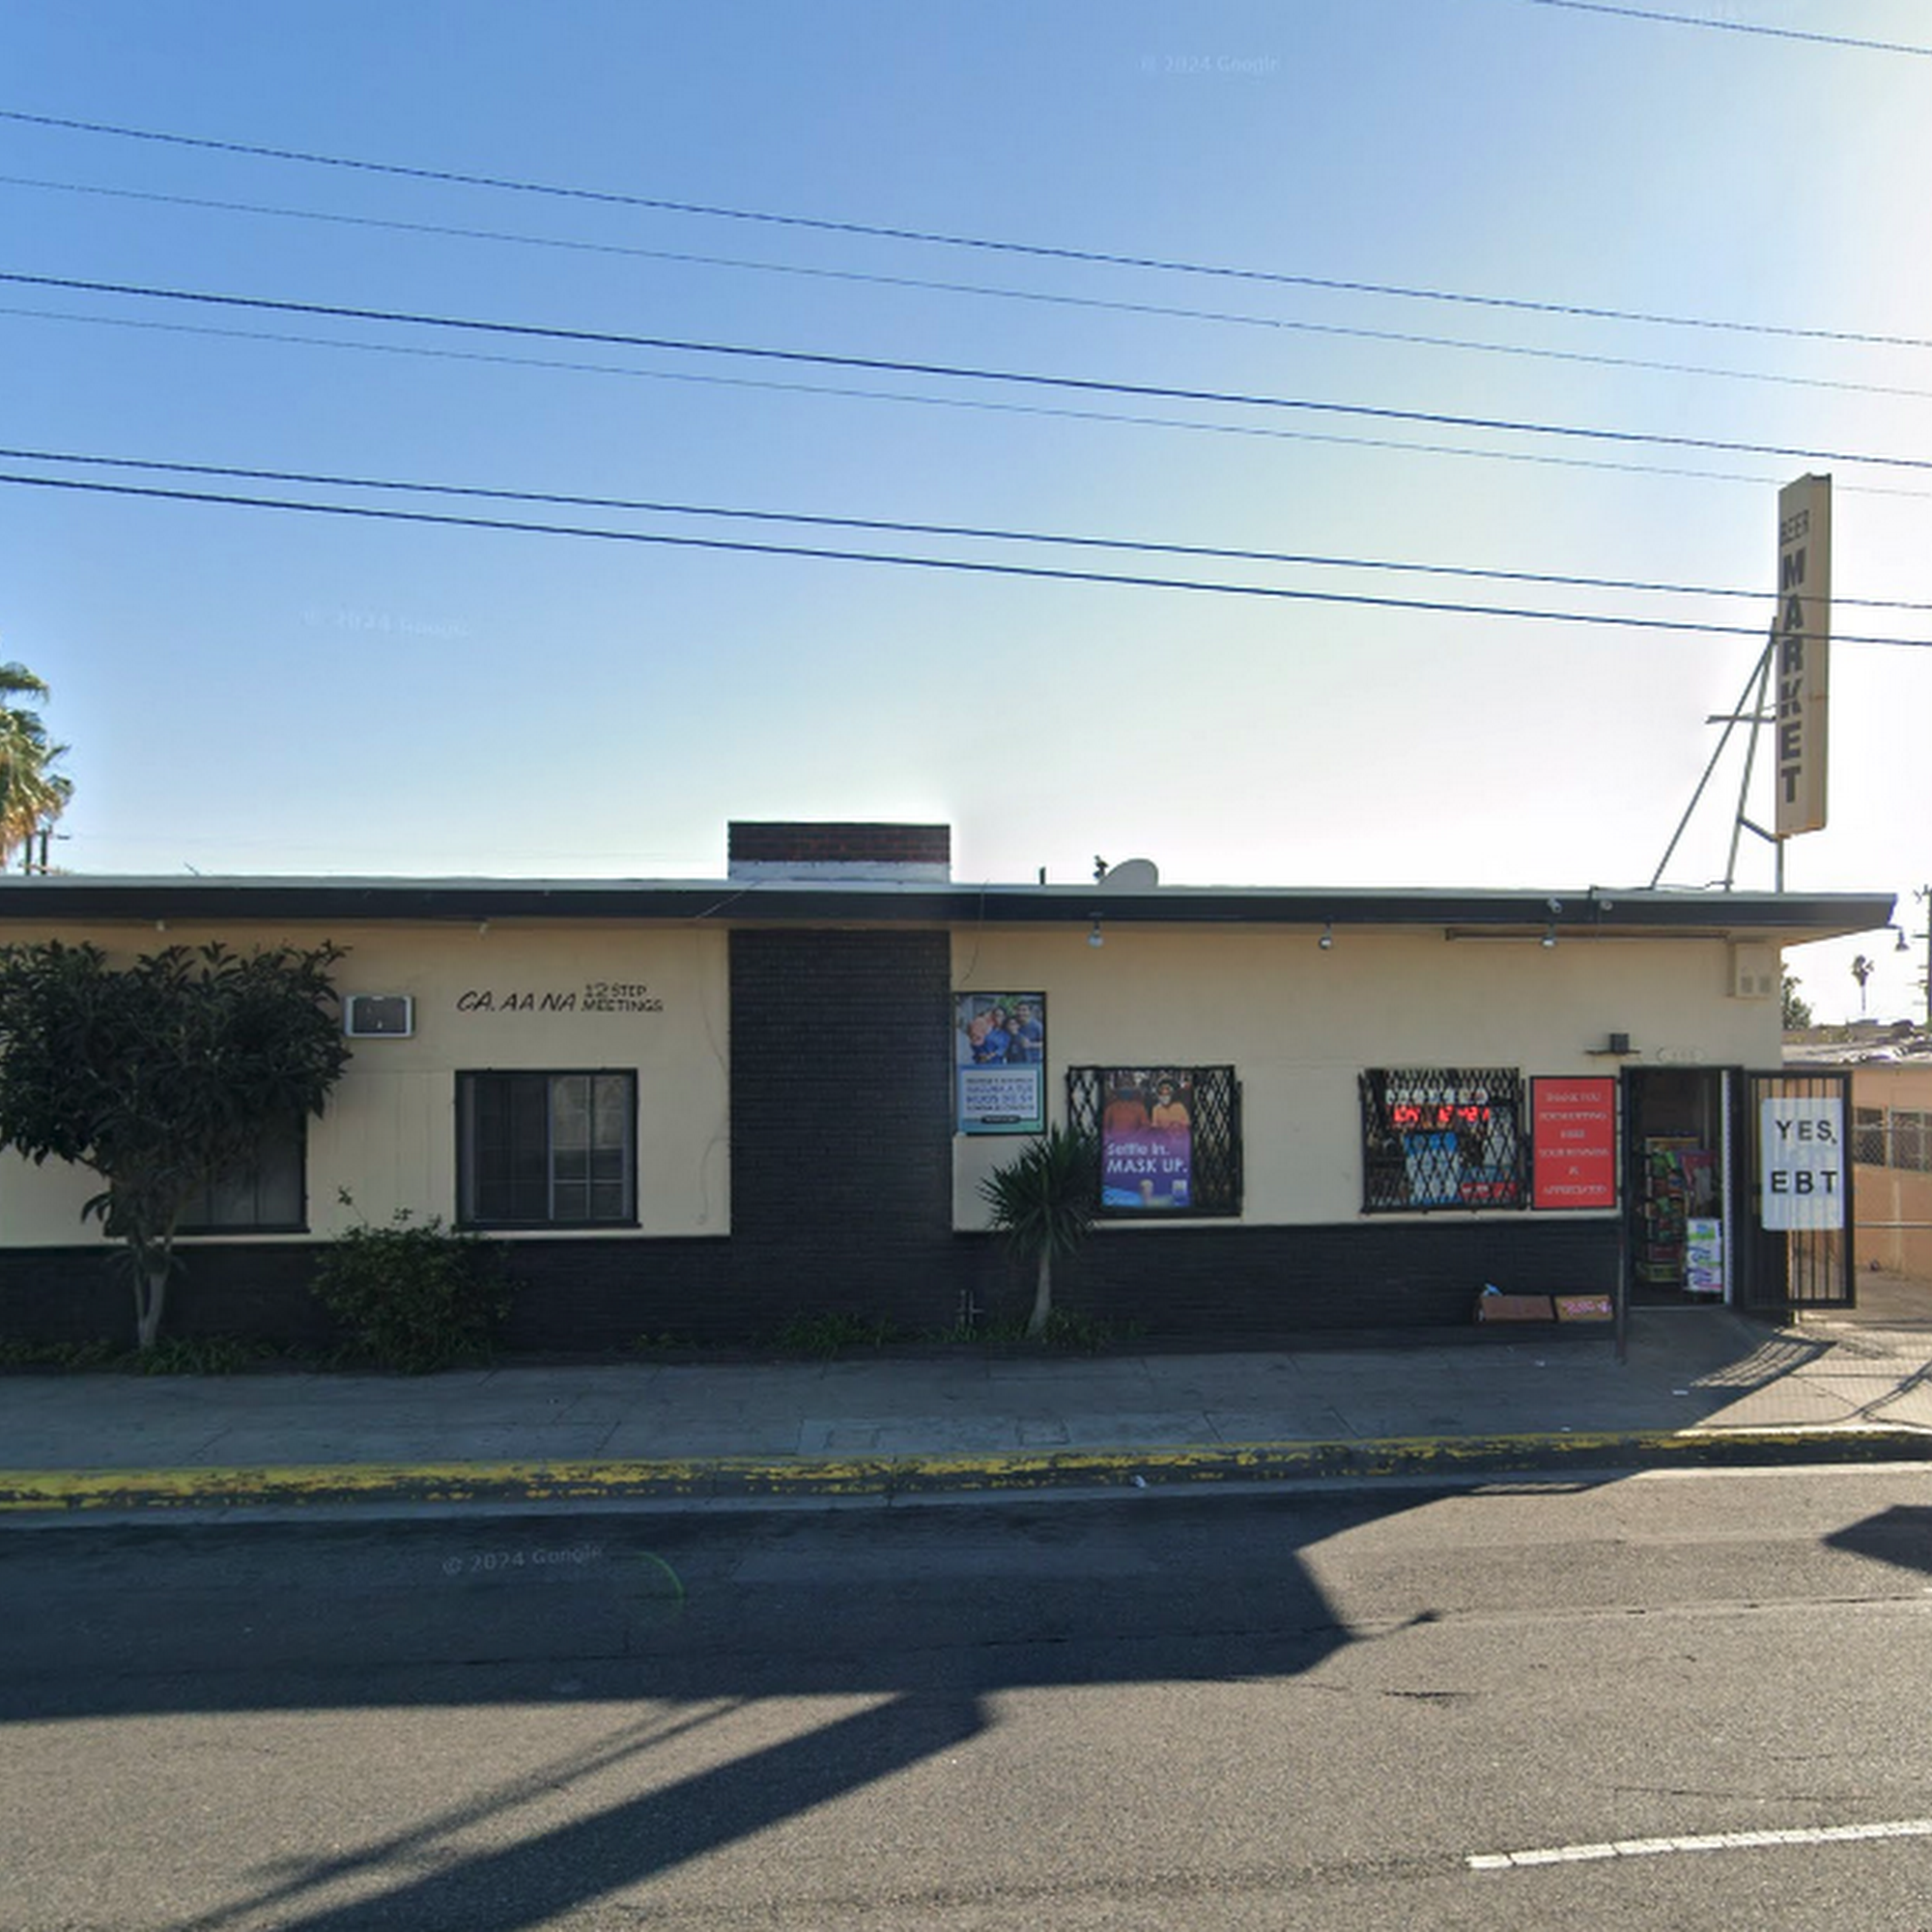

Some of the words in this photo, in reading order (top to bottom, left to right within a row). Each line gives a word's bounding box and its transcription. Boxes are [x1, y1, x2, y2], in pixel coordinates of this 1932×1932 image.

[1779, 546, 1807, 804] MARKET
[585, 981, 609, 998] 12
[611, 983, 647, 998] STEP
[498, 992, 534, 1011] AA
[538, 992, 577, 1011] NA
[581, 998, 664, 1012] MEETINGS
[1107, 1159, 1157, 1173] MASK
[1771, 1171, 1837, 1194] EBT
